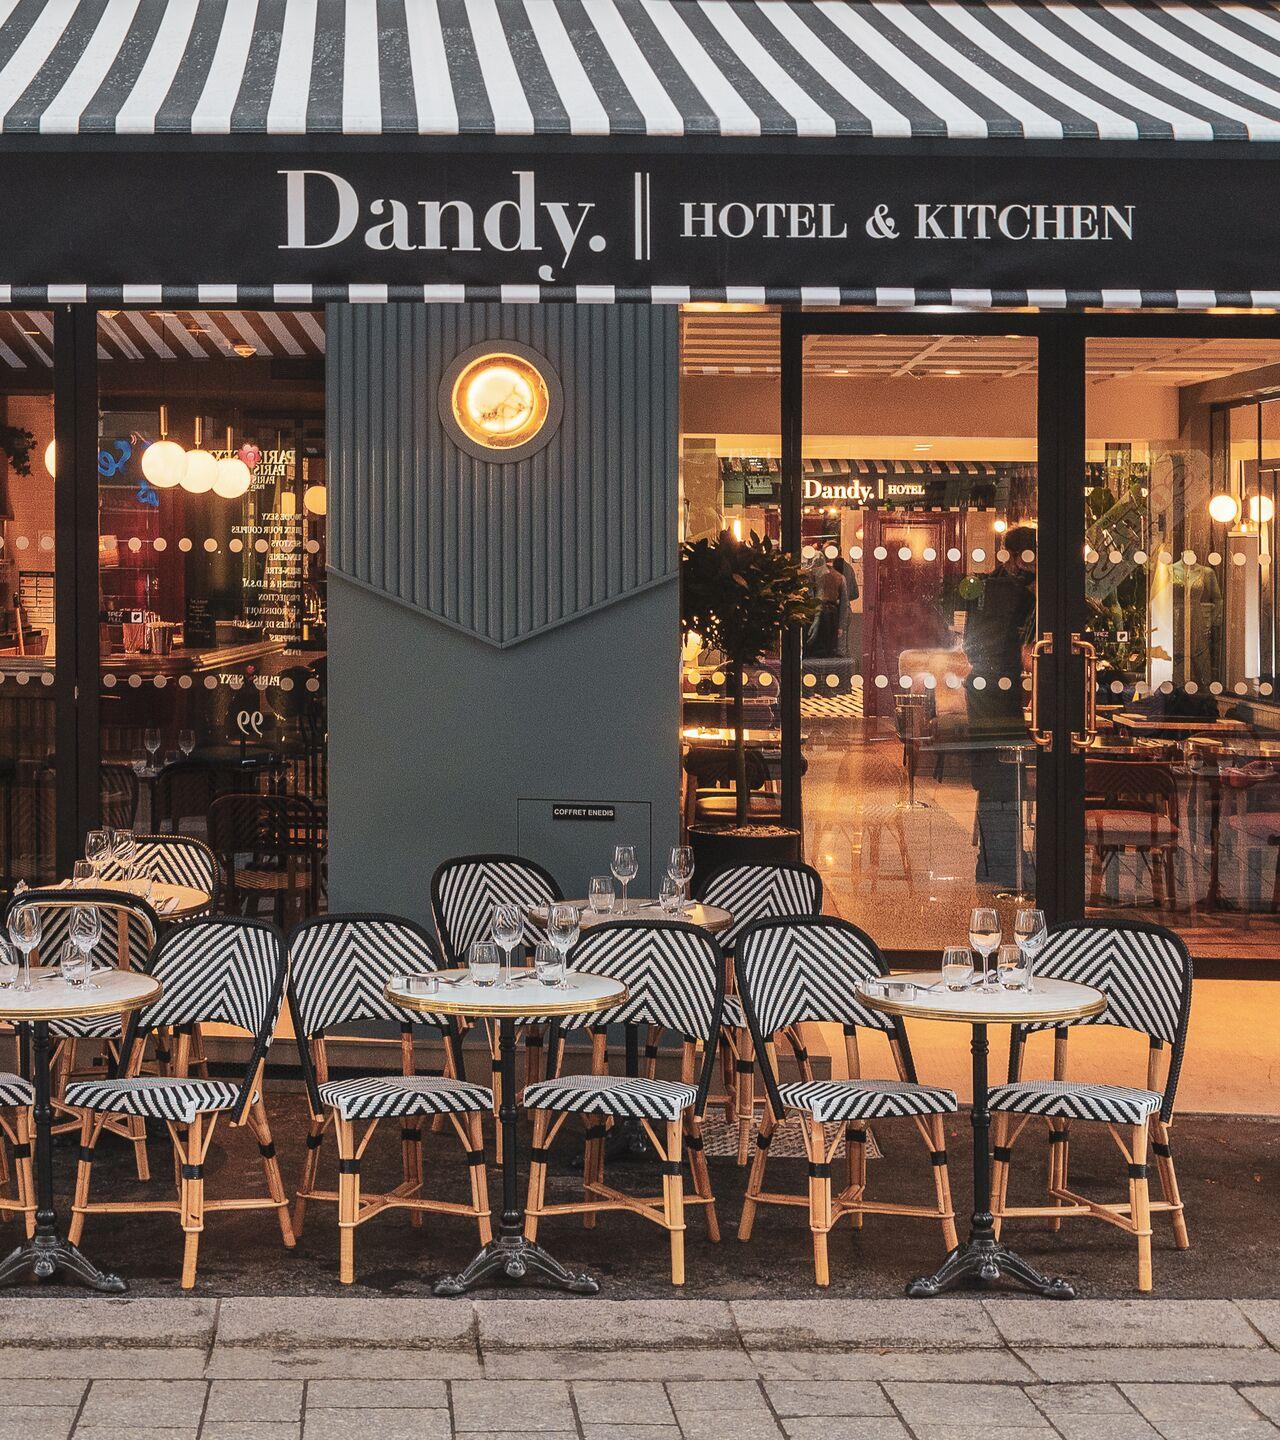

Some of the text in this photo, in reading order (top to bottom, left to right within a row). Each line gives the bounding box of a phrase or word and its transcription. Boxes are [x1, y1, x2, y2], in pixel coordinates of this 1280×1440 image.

[278, 169, 1136, 281] Dandy. HOTEL & KITCHEN
[803, 479, 925, 505] Dandy. HOTEL
[553, 808, 614, 817] COFFRET ENEDIS
